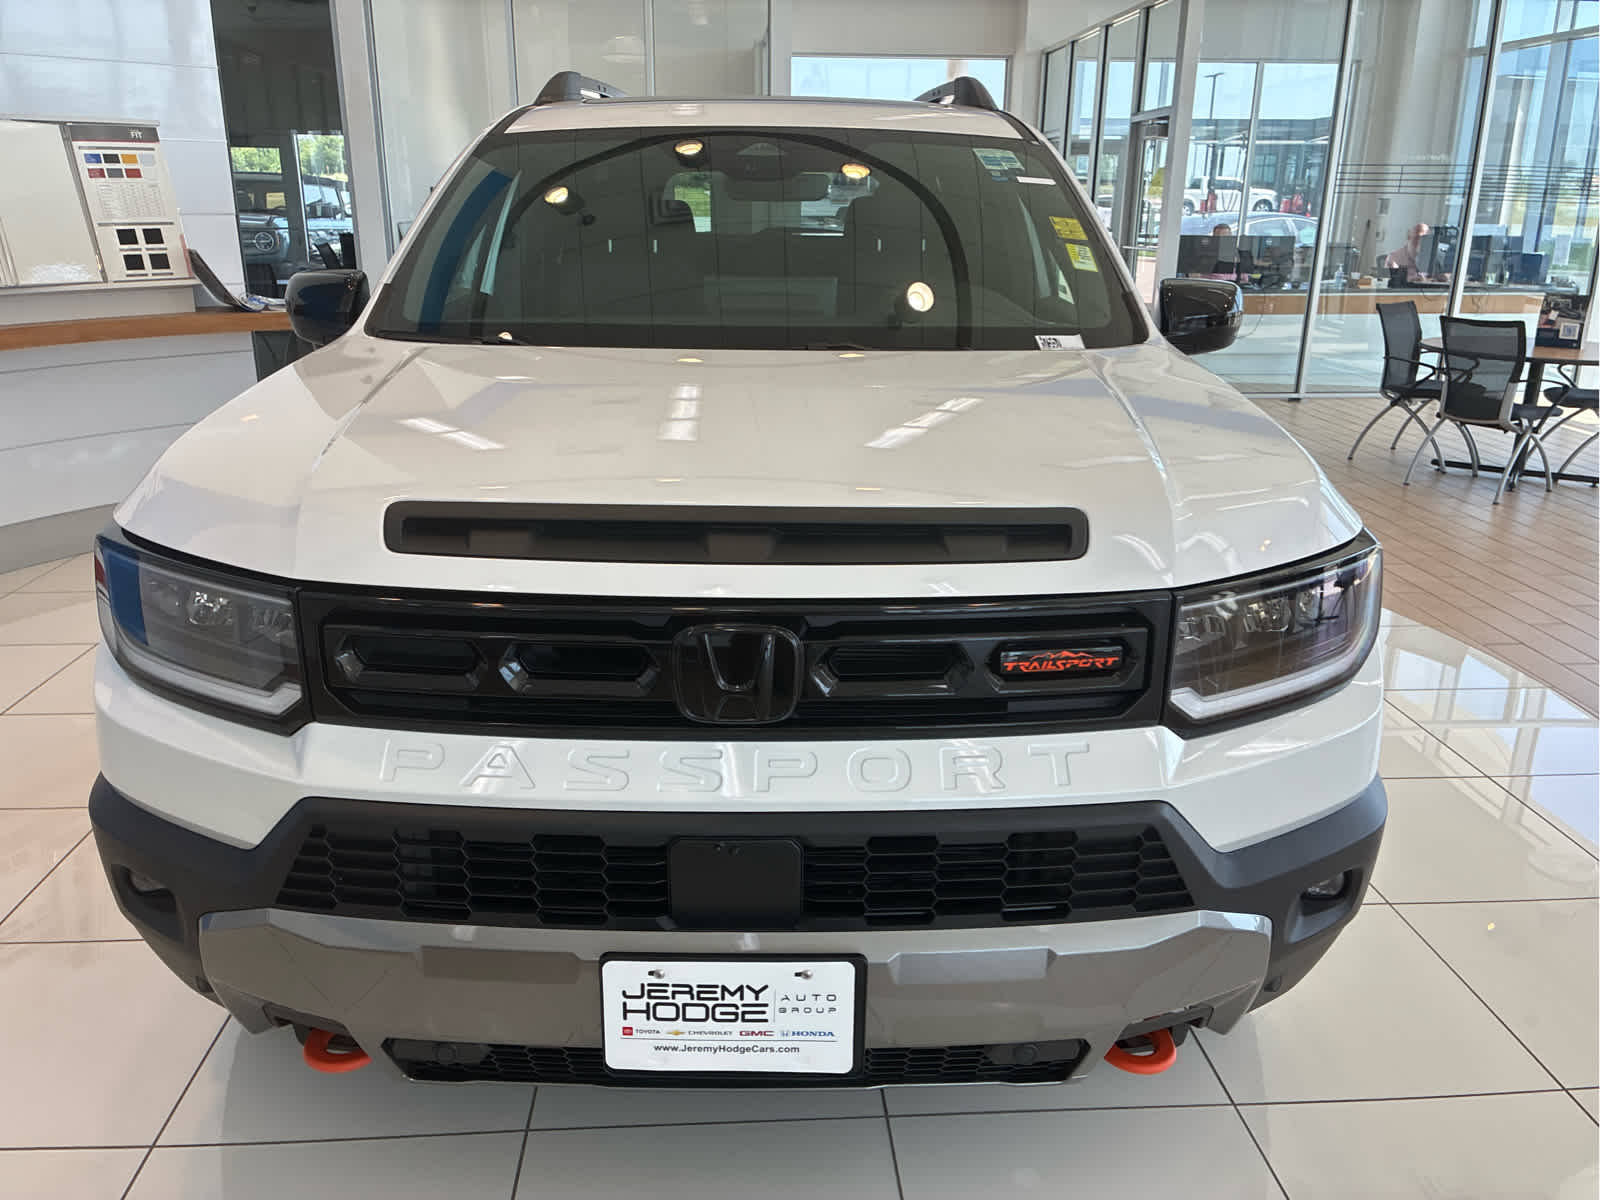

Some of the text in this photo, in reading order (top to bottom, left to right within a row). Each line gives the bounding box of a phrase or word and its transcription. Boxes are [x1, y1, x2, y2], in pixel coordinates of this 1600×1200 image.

[1003, 656, 1119, 672] TRAILSPORT
[379, 737, 1090, 793] PASSPORT
[622, 983, 769, 1001] JEREMY
[781, 994, 838, 1002] AUTO
[622, 1002, 769, 1023] HODGE
[654, 1044, 800, 1054] www.JeremyHodgeCars.com
